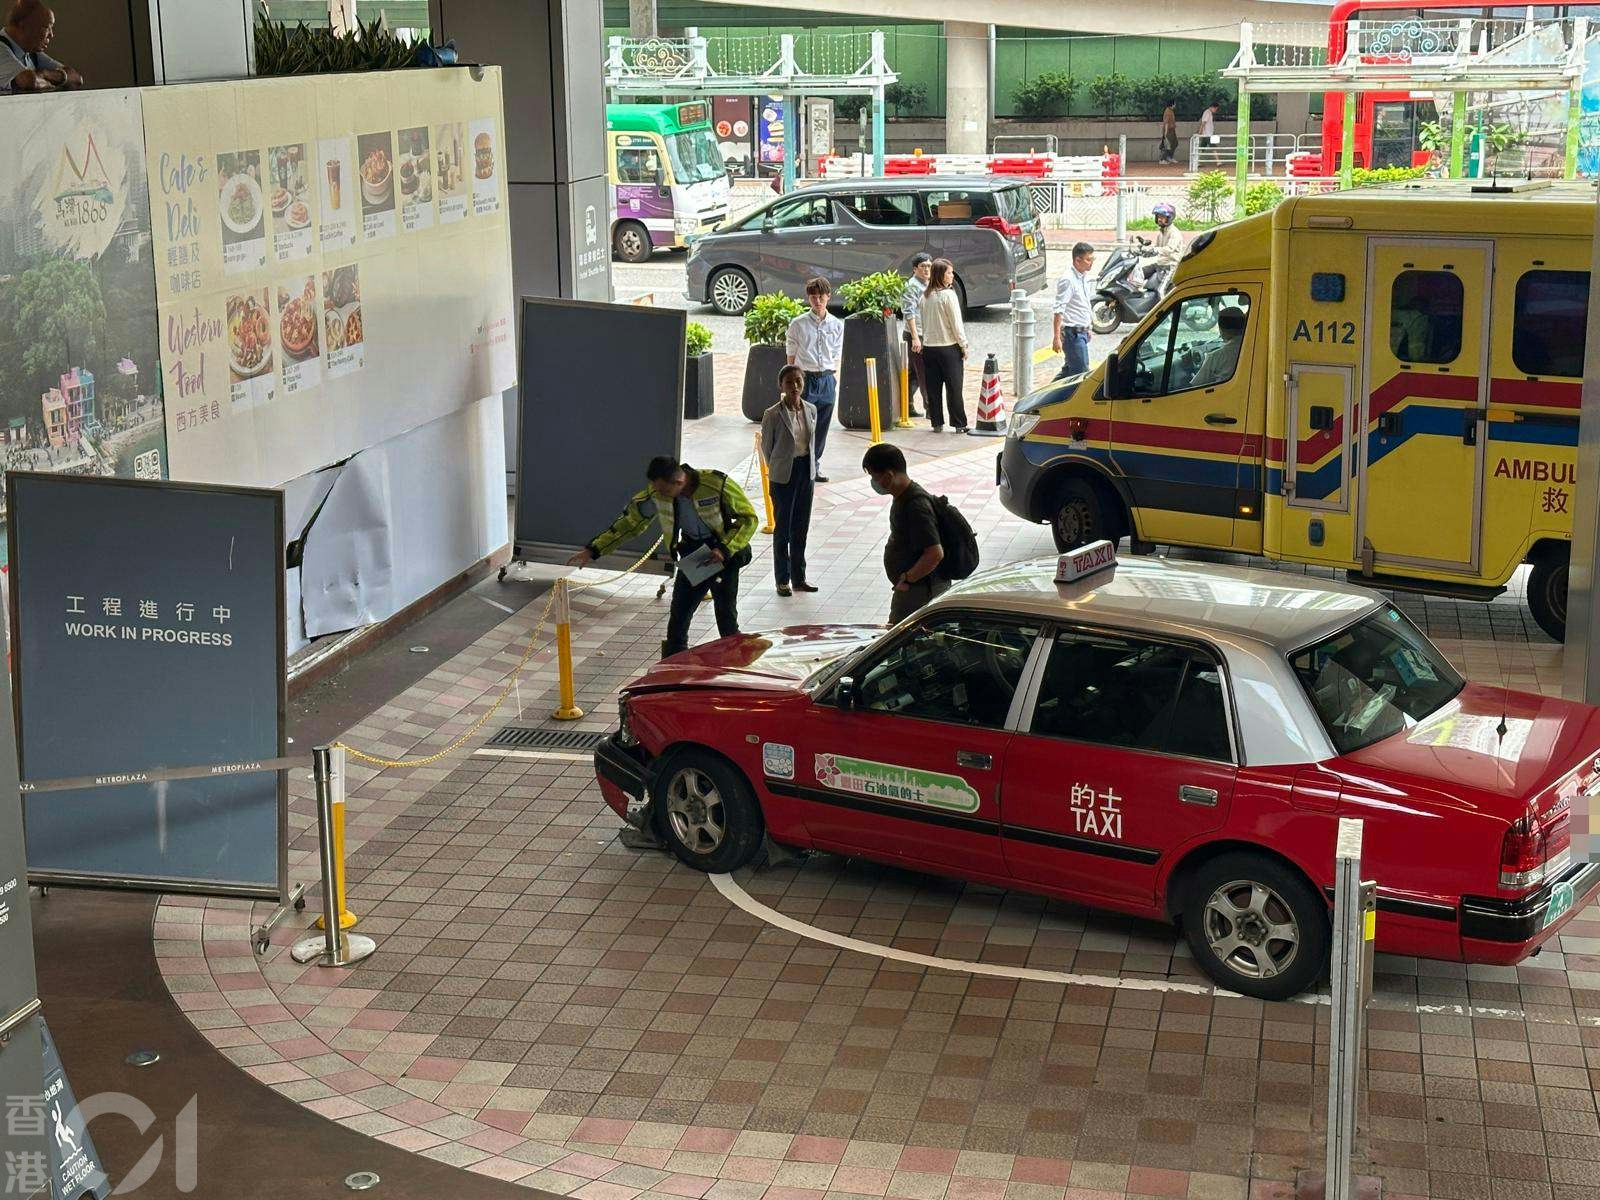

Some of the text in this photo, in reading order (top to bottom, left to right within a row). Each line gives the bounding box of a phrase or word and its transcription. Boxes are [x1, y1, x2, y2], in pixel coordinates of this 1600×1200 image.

[166, 197, 200, 241] Deli
[167, 307, 223, 355] Western
[1292, 319, 1356, 345] A112
[169, 352, 206, 398] Food
[176, 400, 220, 432] 西方美食
[1542, 487, 1569, 514] 救
[1072, 544, 1113, 573] TAXI
[66, 595, 231, 625] 工程進行中
[65, 622, 233, 647] WORK IN PROGRESS
[95, 774, 147, 785] METROPLAZA
[211, 763, 261, 773] METROPLAZA
[1070, 782, 1122, 813] 的士
[1070, 806, 1122, 839] TAXI
[61, 1161, 96, 1196] WET FLOOR
[62, 1153, 88, 1181] CAUTION
